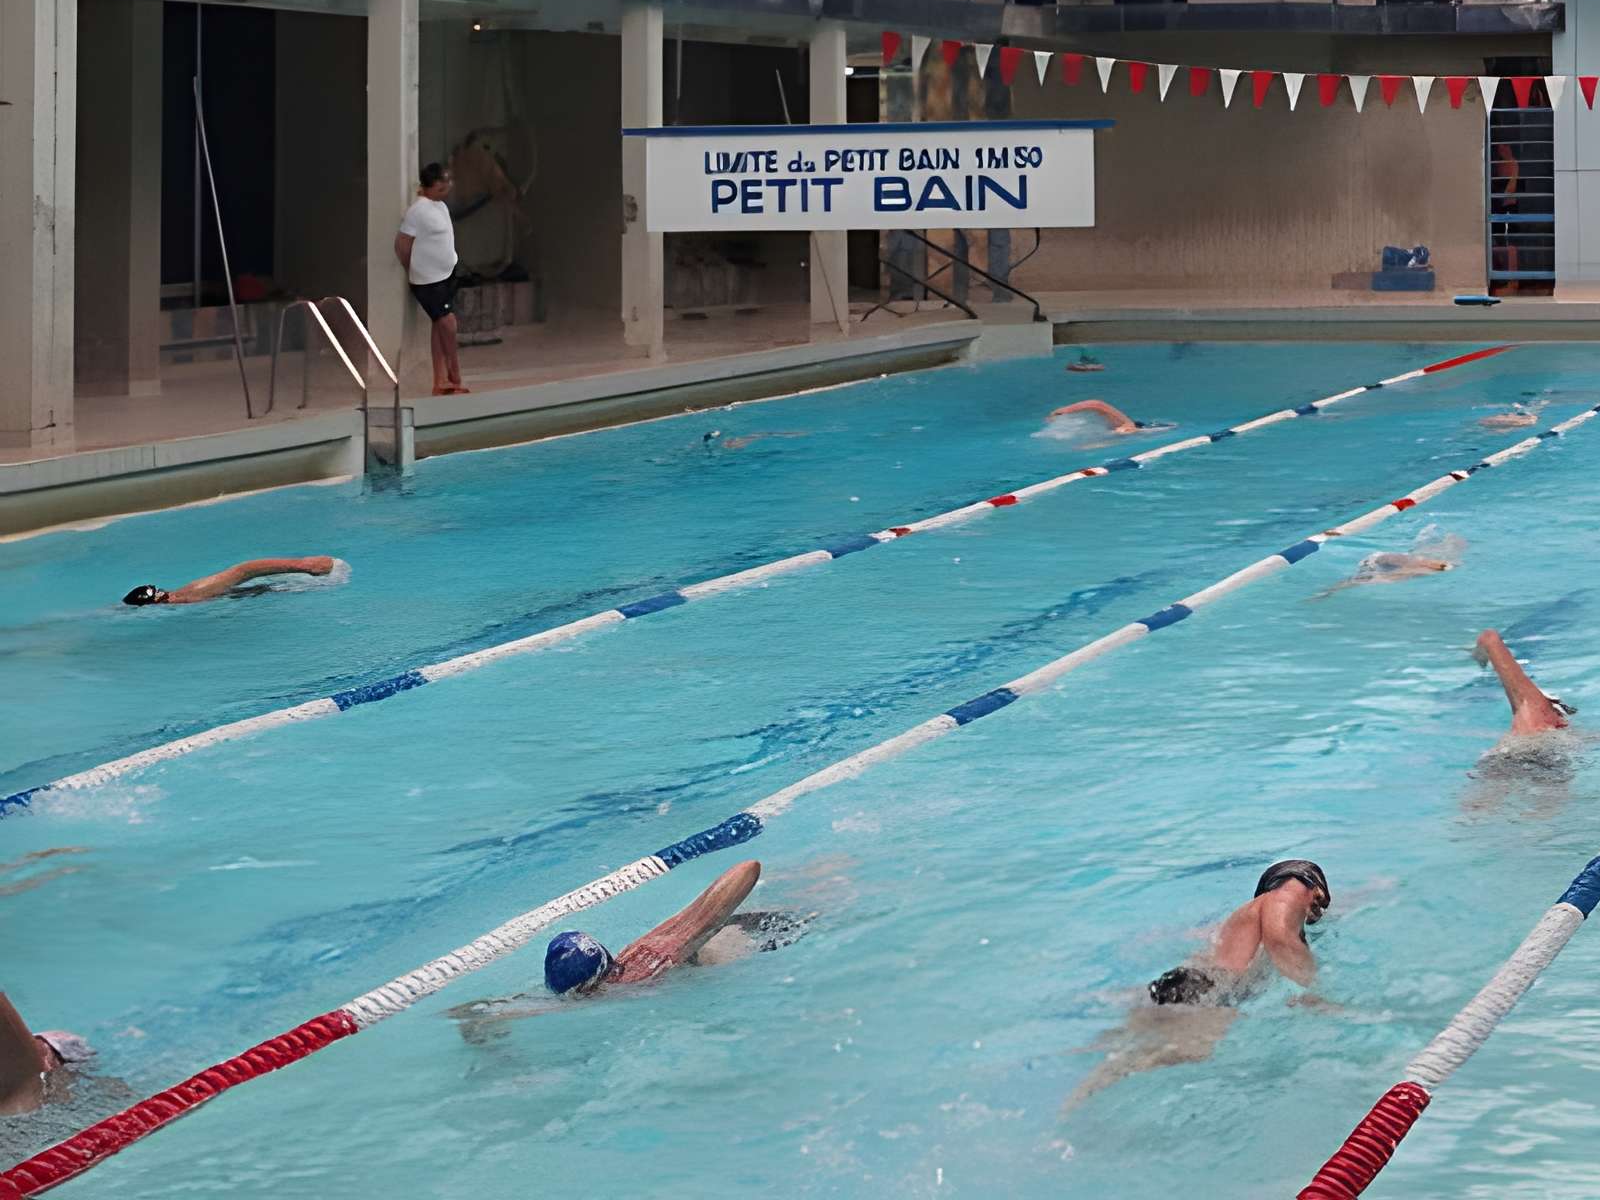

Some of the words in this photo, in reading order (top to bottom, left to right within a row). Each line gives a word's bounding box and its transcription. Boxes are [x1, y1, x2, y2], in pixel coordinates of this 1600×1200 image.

[825, 149, 889, 173] PETIT
[899, 148, 960, 171] BAIN
[711, 177, 844, 214] PETIT
[874, 174, 1028, 212] BAIN
